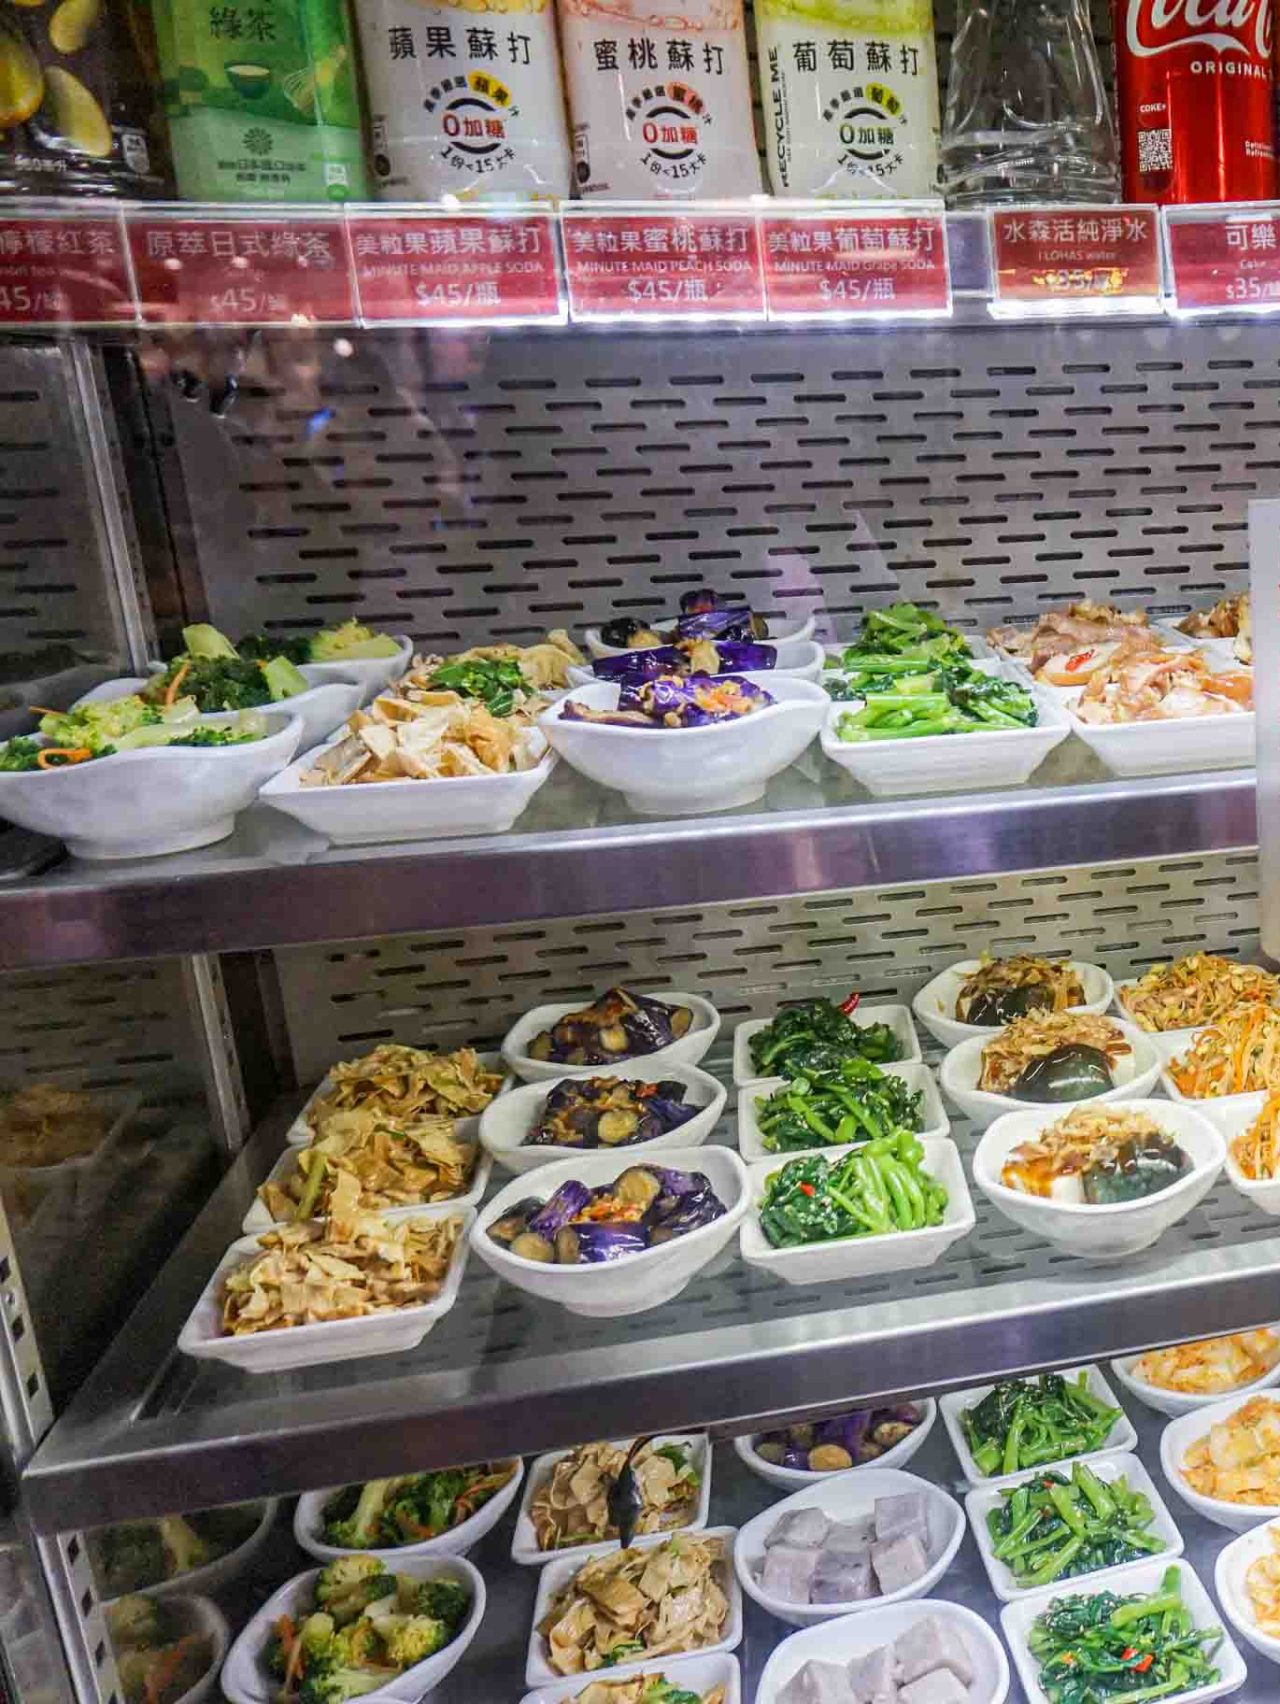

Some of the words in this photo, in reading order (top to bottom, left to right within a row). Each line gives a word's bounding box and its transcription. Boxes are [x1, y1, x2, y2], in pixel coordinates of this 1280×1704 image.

[209, 6, 278, 42] 綠茶
[388, 26, 532, 65] 蘋果蘇打
[593, 37, 724, 76] 蜜桃蘇打
[792, 39, 919, 76] 葡萄蘇打
[768, 46, 780, 83] ME
[1190, 61, 1267, 79] ORIGINAL
[642, 122, 698, 145] 0加糖
[771, 89, 790, 187] RECYCLE
[839, 123, 895, 145] 0加糖
[147, 231, 331, 257] 原萃日式綠茶
[356, 226, 541, 255] 美粒果蘋果蘇打
[572, 224, 749, 253] 美粒果蜜桃蘇打
[768, 226, 935, 253] 美粒果葡萄蘇打
[1003, 217, 1149, 244] 水森活純淨水
[1225, 223, 1277, 250] 可樂
[506, 261, 545, 273] SODA
[577, 261, 629, 273] MINUTE
[632, 260, 668, 273] MAID
[717, 261, 752, 271] SODA
[416, 281, 501, 306] $45/瓶
[628, 278, 707, 302] $45/瓶
[819, 278, 896, 301] $45/瓶
